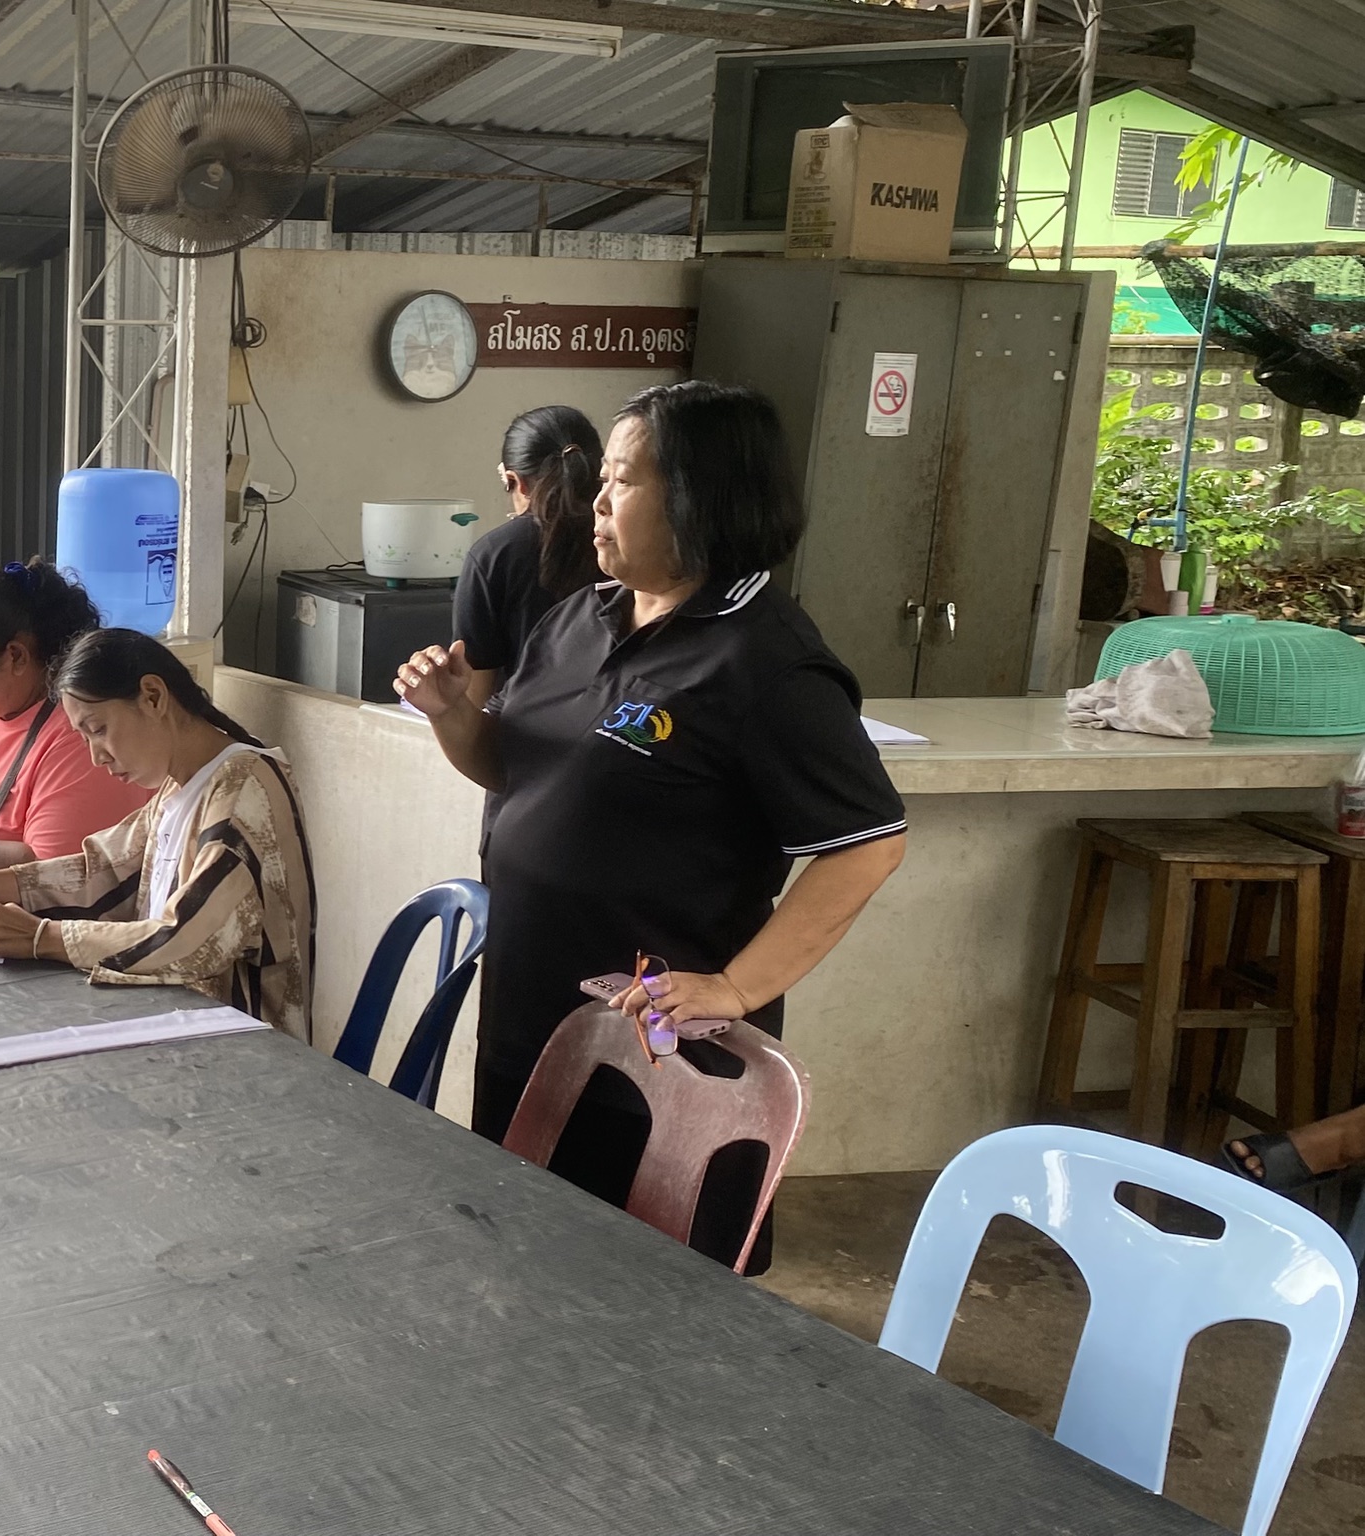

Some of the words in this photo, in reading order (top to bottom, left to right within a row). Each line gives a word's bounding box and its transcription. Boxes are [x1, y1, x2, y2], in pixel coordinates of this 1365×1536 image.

[870, 183, 939, 212] KASHIWA
[487, 309, 562, 351] สโมสร
[603, 701, 655, 730] 51
